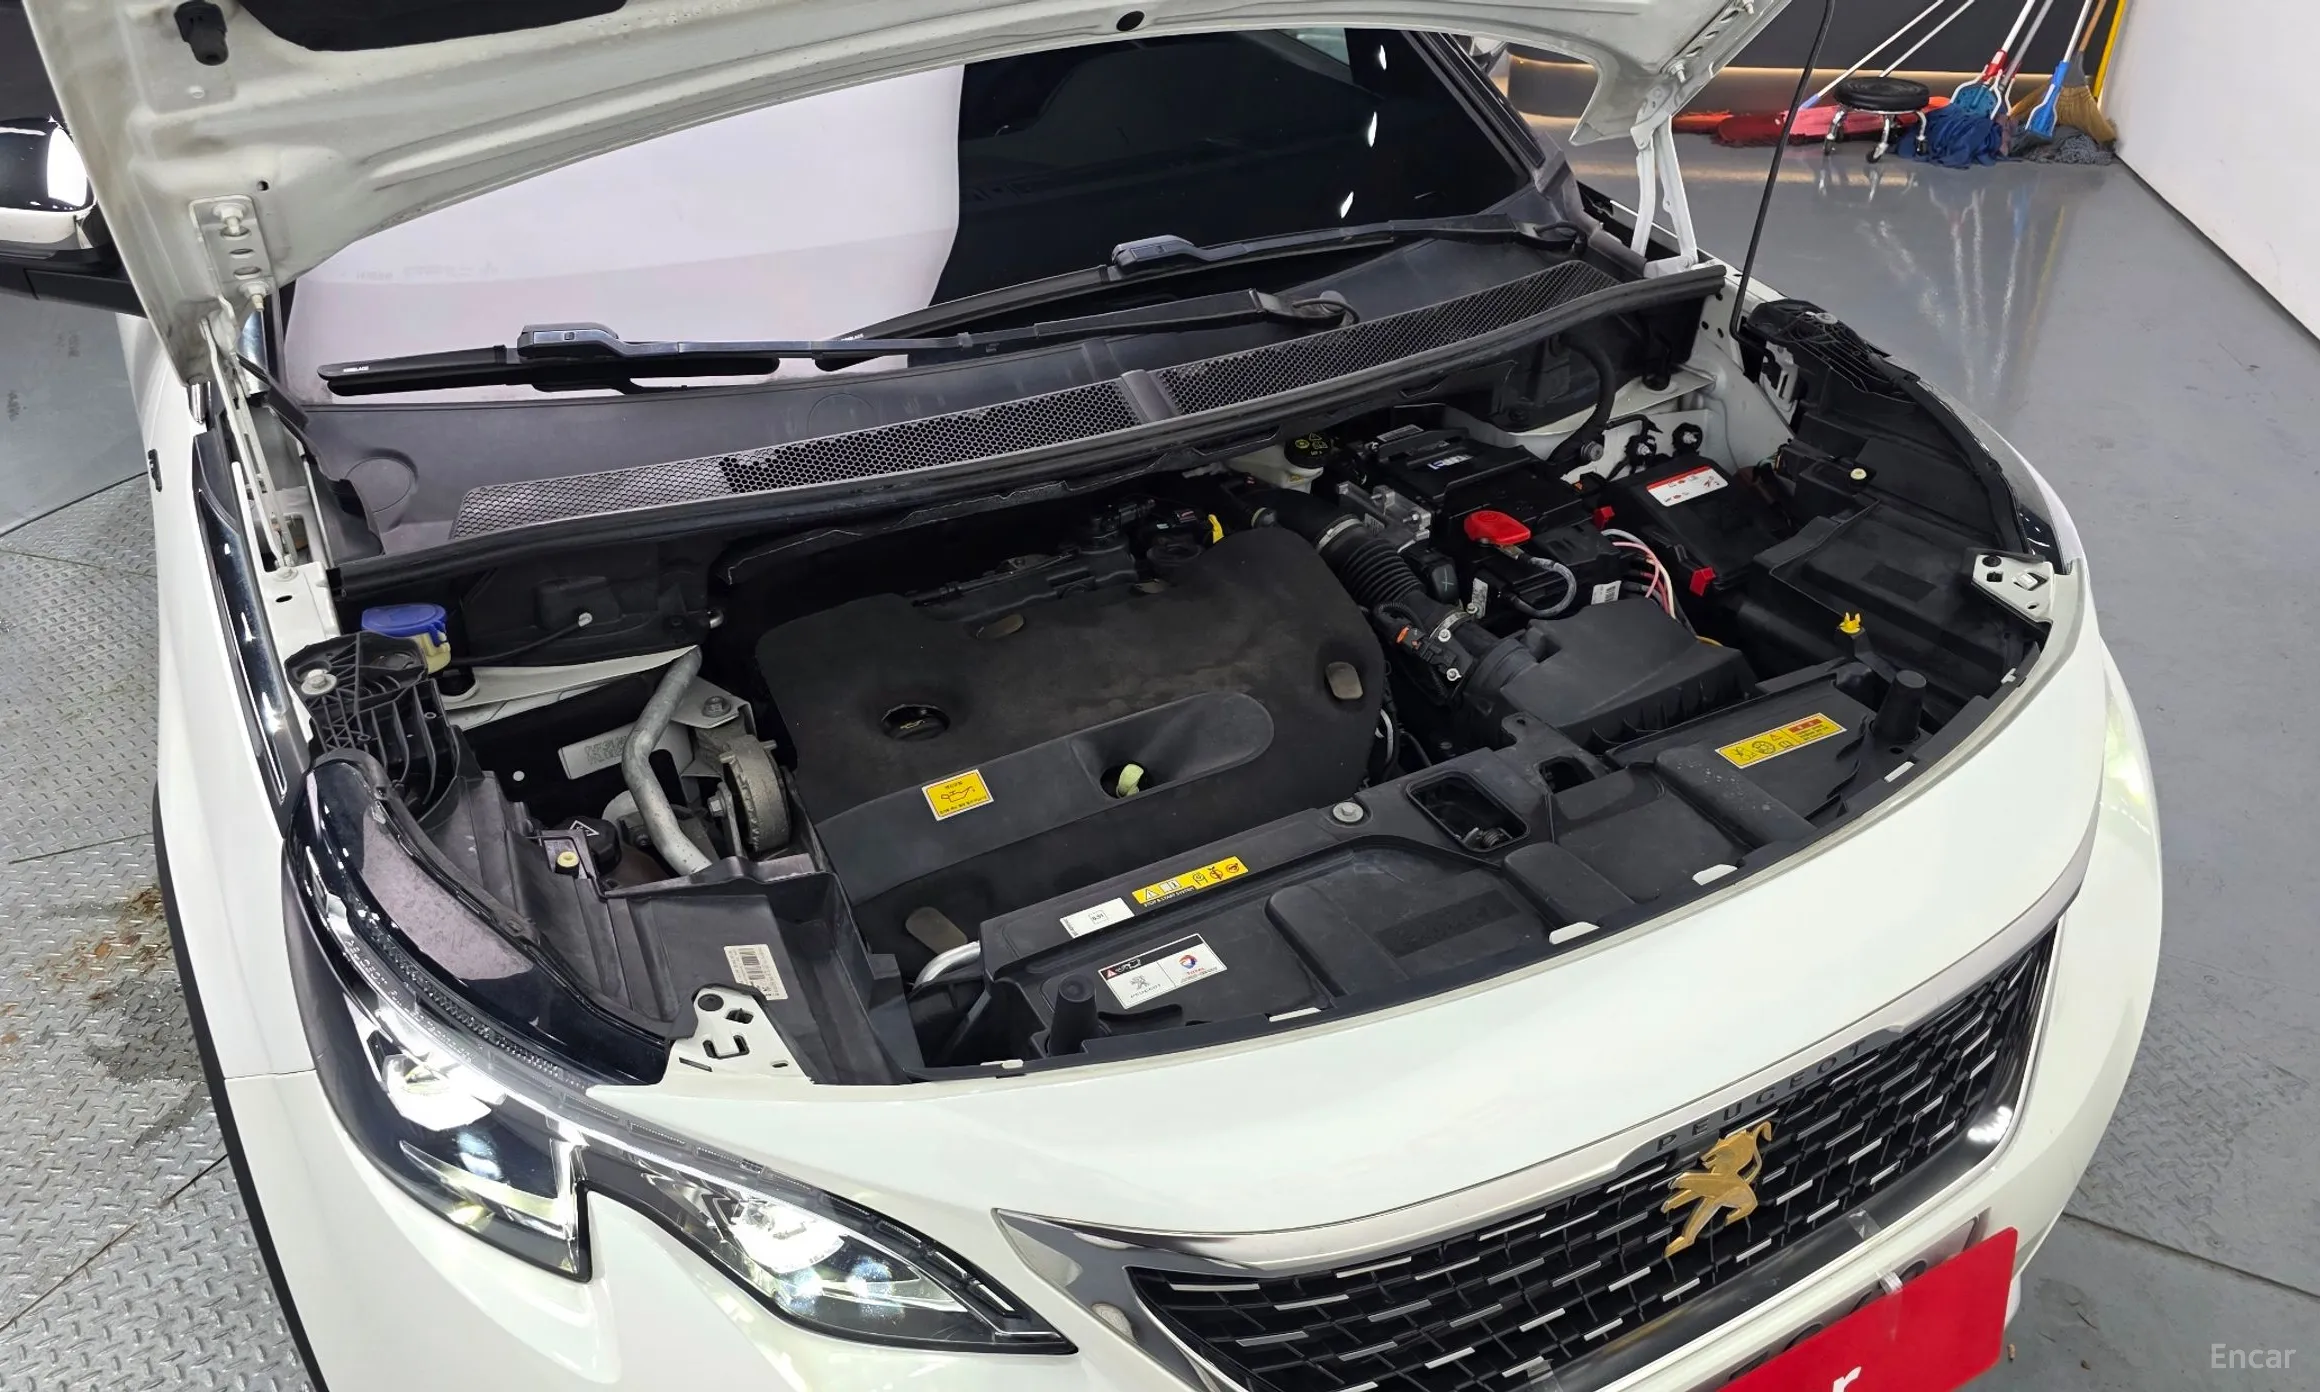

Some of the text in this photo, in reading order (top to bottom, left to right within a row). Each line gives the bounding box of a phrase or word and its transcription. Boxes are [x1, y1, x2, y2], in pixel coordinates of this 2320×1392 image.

[1175, 886, 1195, 896] SYSTEM
[345, 940, 388, 985] PEUGEOT
[1656, 1039, 1866, 1151] PEUGEOT
